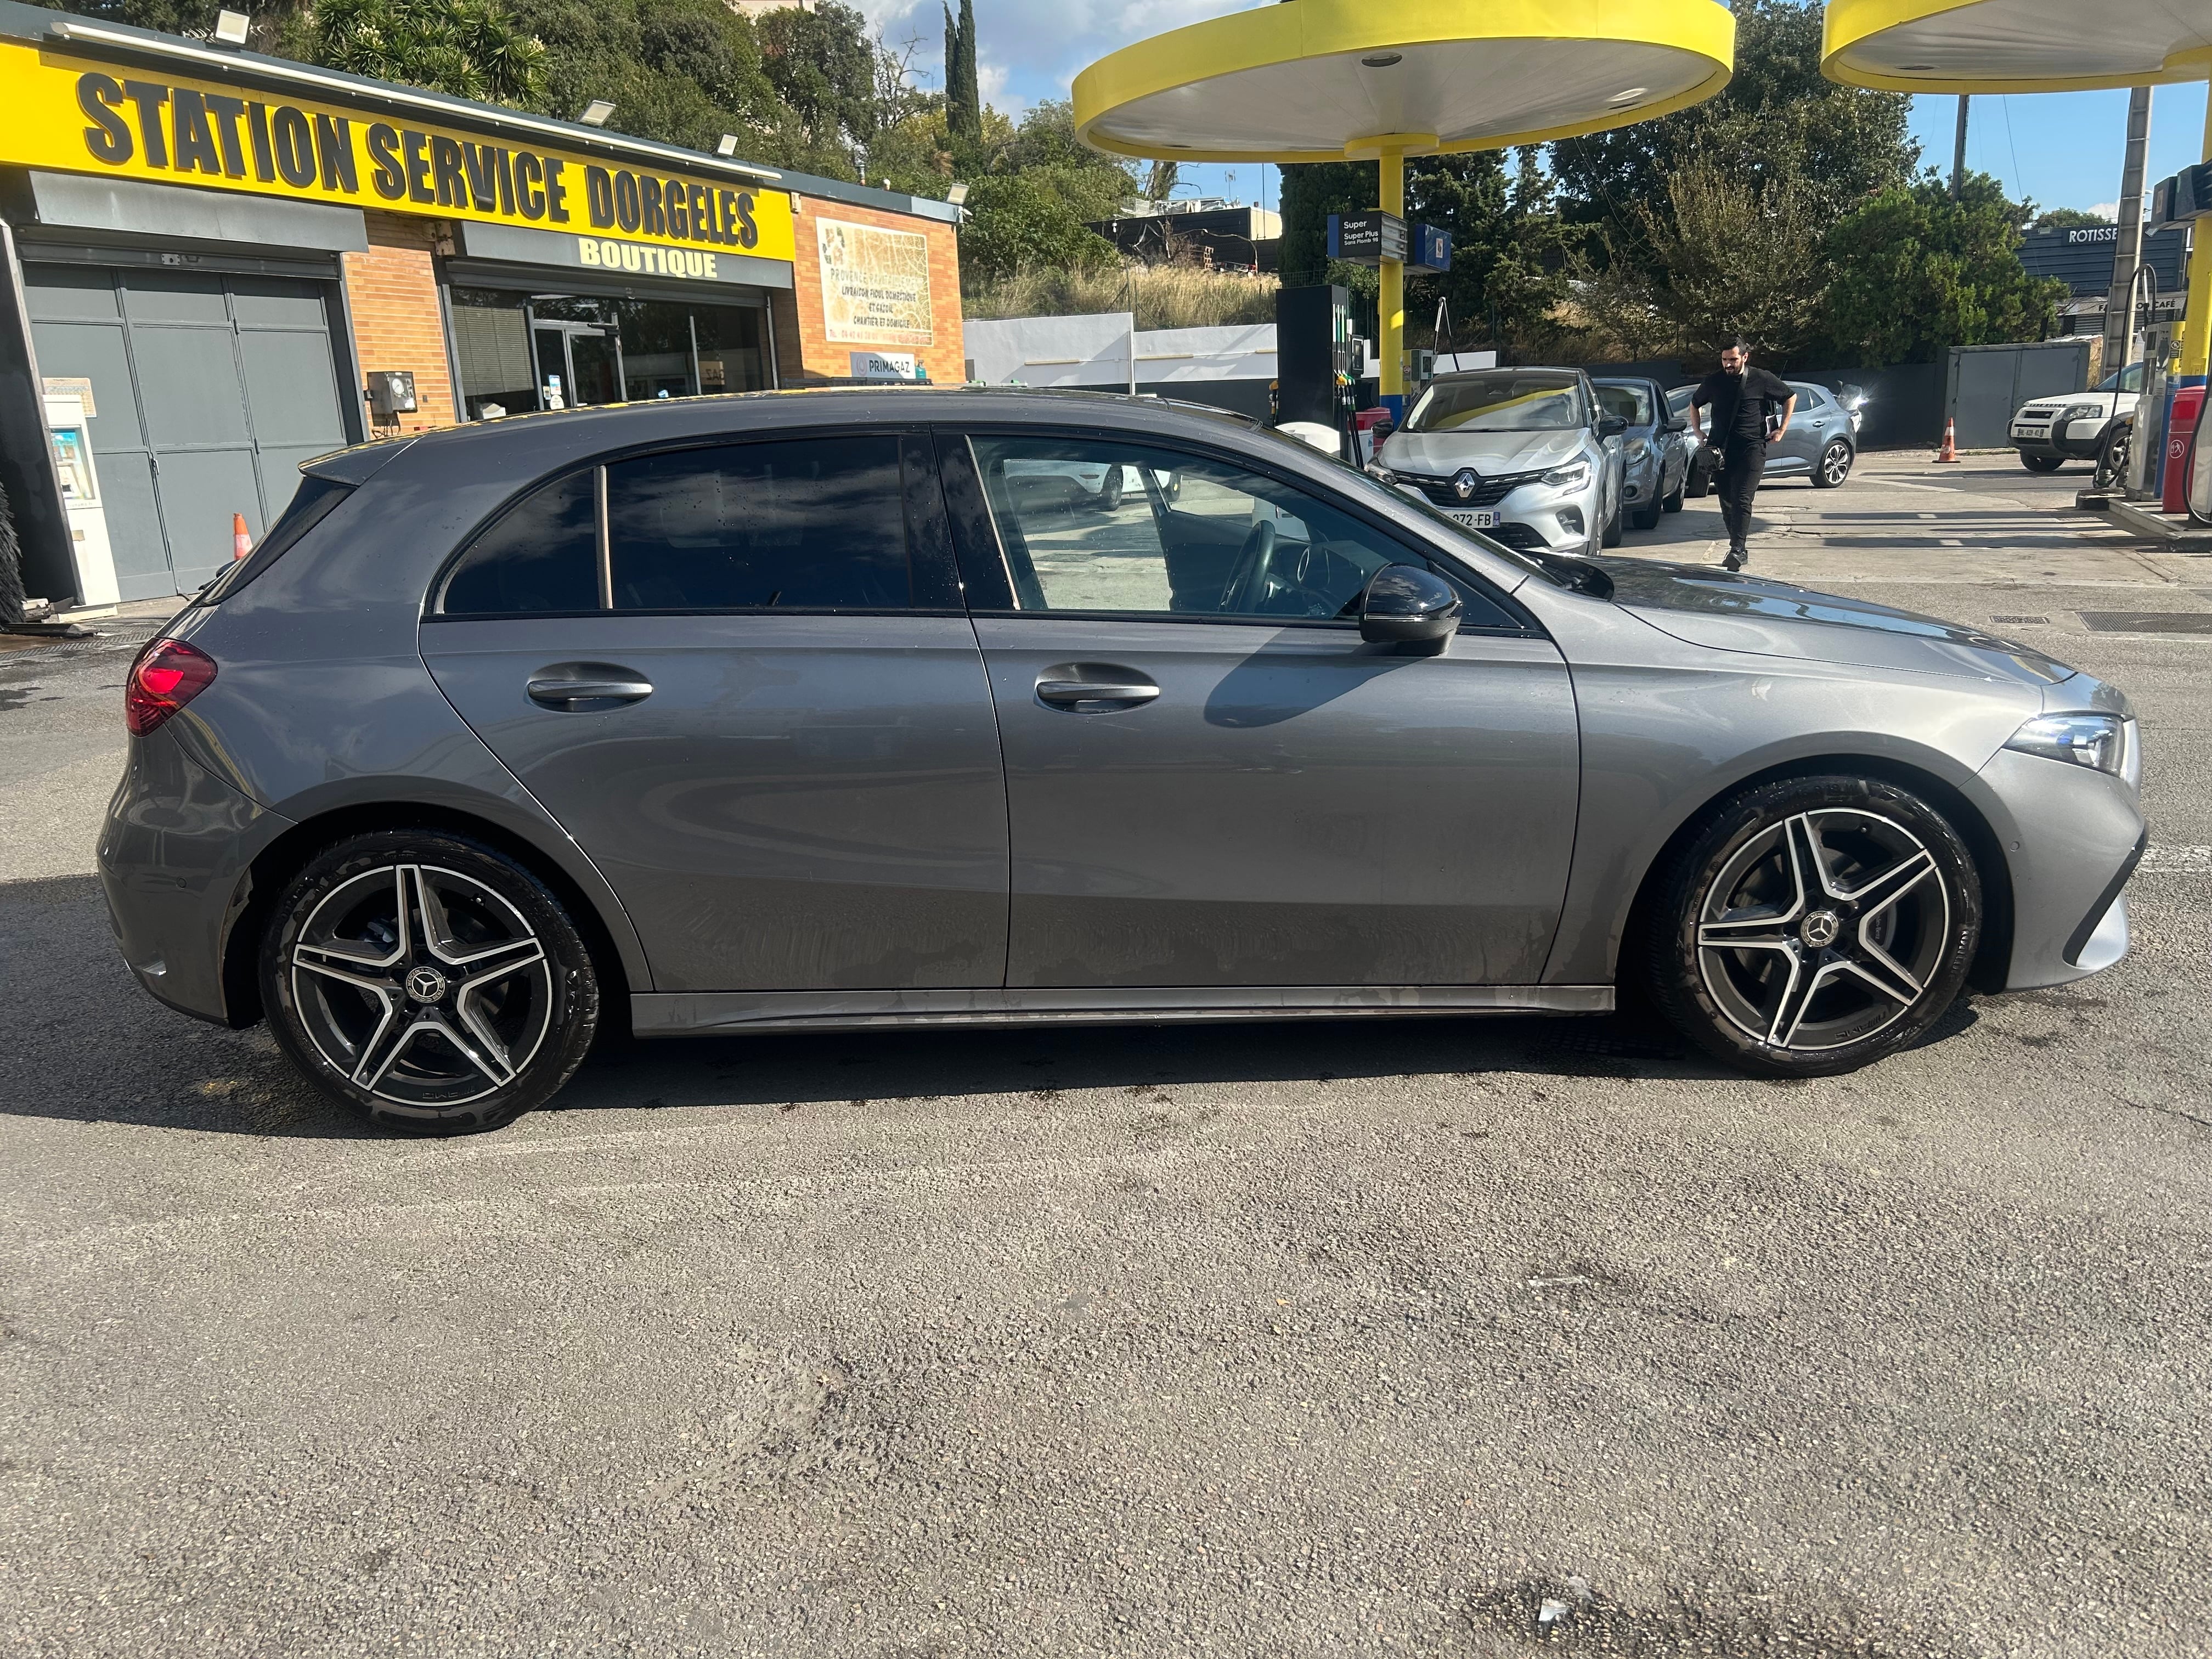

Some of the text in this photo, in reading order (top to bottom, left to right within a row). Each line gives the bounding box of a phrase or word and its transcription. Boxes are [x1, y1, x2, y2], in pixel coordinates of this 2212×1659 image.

[77, 72, 758, 249] STATION SERVICE DORGELES
[1344, 221, 1367, 229] Super
[578, 238, 718, 278] BOUTIQUE
[831, 268, 868, 285] PROVENCE
[842, 286, 916, 302] LIVRAISON FIOUL DOMESTIQUE
[868, 302, 876, 312] ET
[854, 315, 910, 329] CHANTIER ET DOMICILE
[869, 360, 910, 373] PRIMAGAZ
